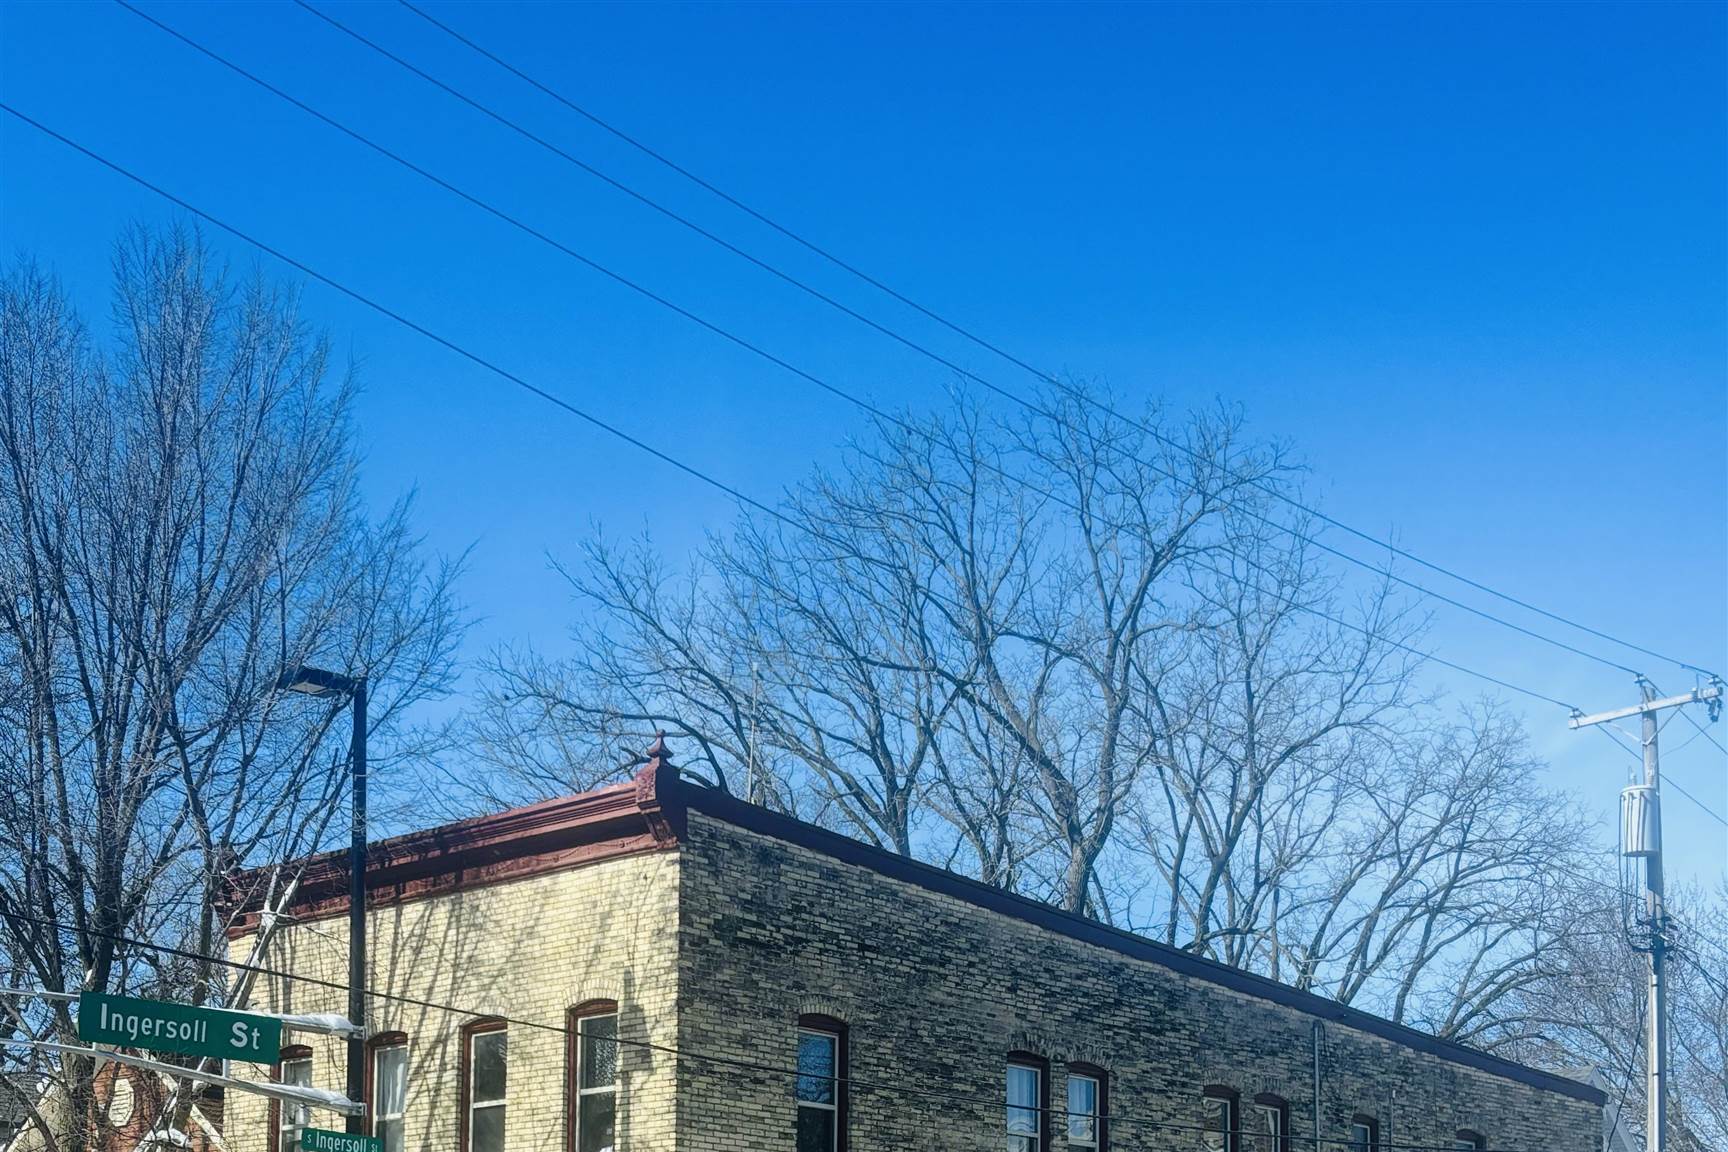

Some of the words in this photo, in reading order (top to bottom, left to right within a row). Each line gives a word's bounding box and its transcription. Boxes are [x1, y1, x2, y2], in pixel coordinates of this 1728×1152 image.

[100, 1003, 207, 1042] Ingersoll
[229, 1021, 261, 1050] St
[306, 1134, 312, 1144] S
